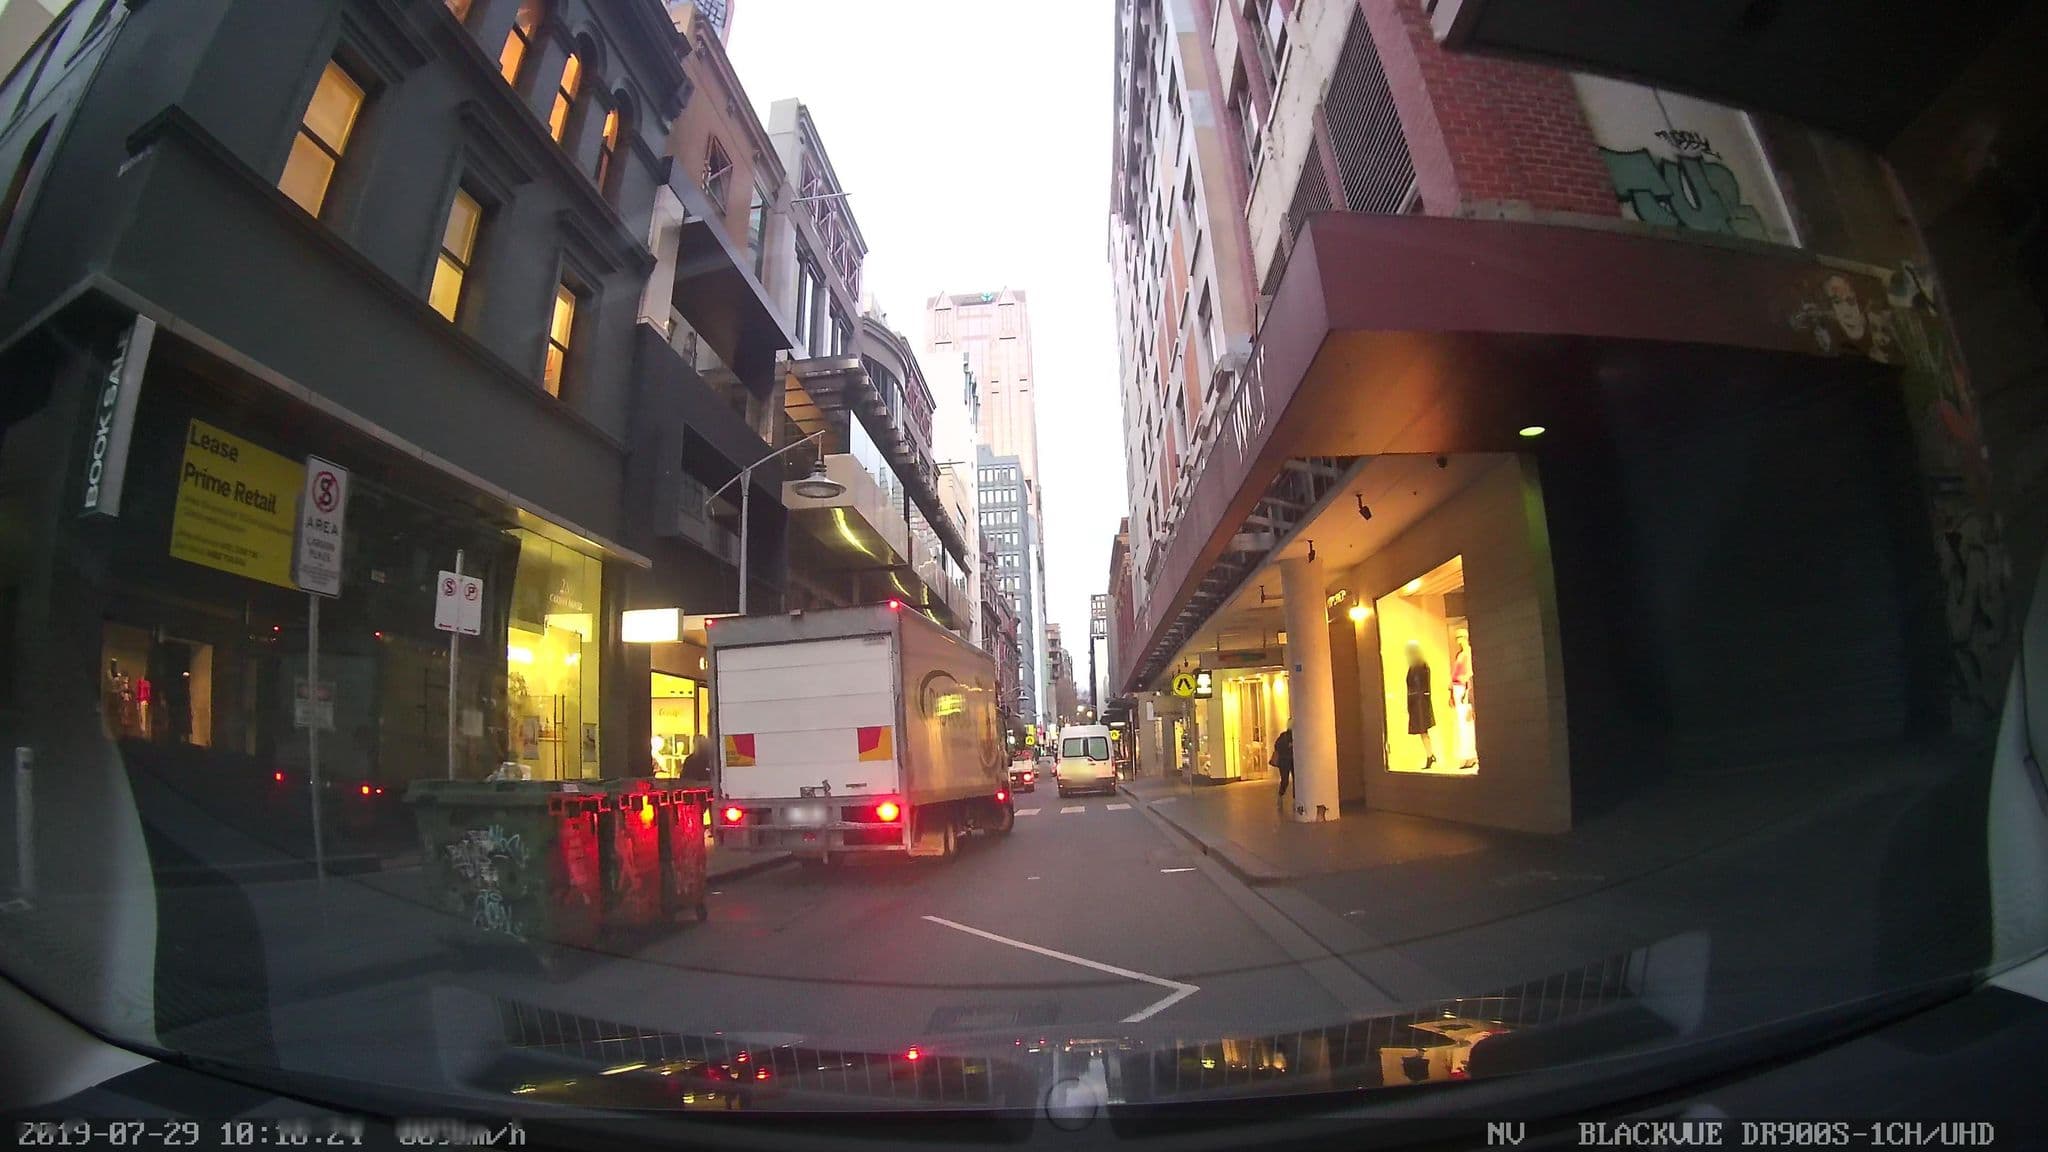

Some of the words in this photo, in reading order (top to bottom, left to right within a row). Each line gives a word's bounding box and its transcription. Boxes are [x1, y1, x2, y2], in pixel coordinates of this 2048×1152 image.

[84, 411, 113, 508] BOOK
[190, 424, 239, 464] Lease
[183, 461, 231, 498] Prime
[234, 480, 278, 515] Retail
[304, 516, 339, 537] AREA
